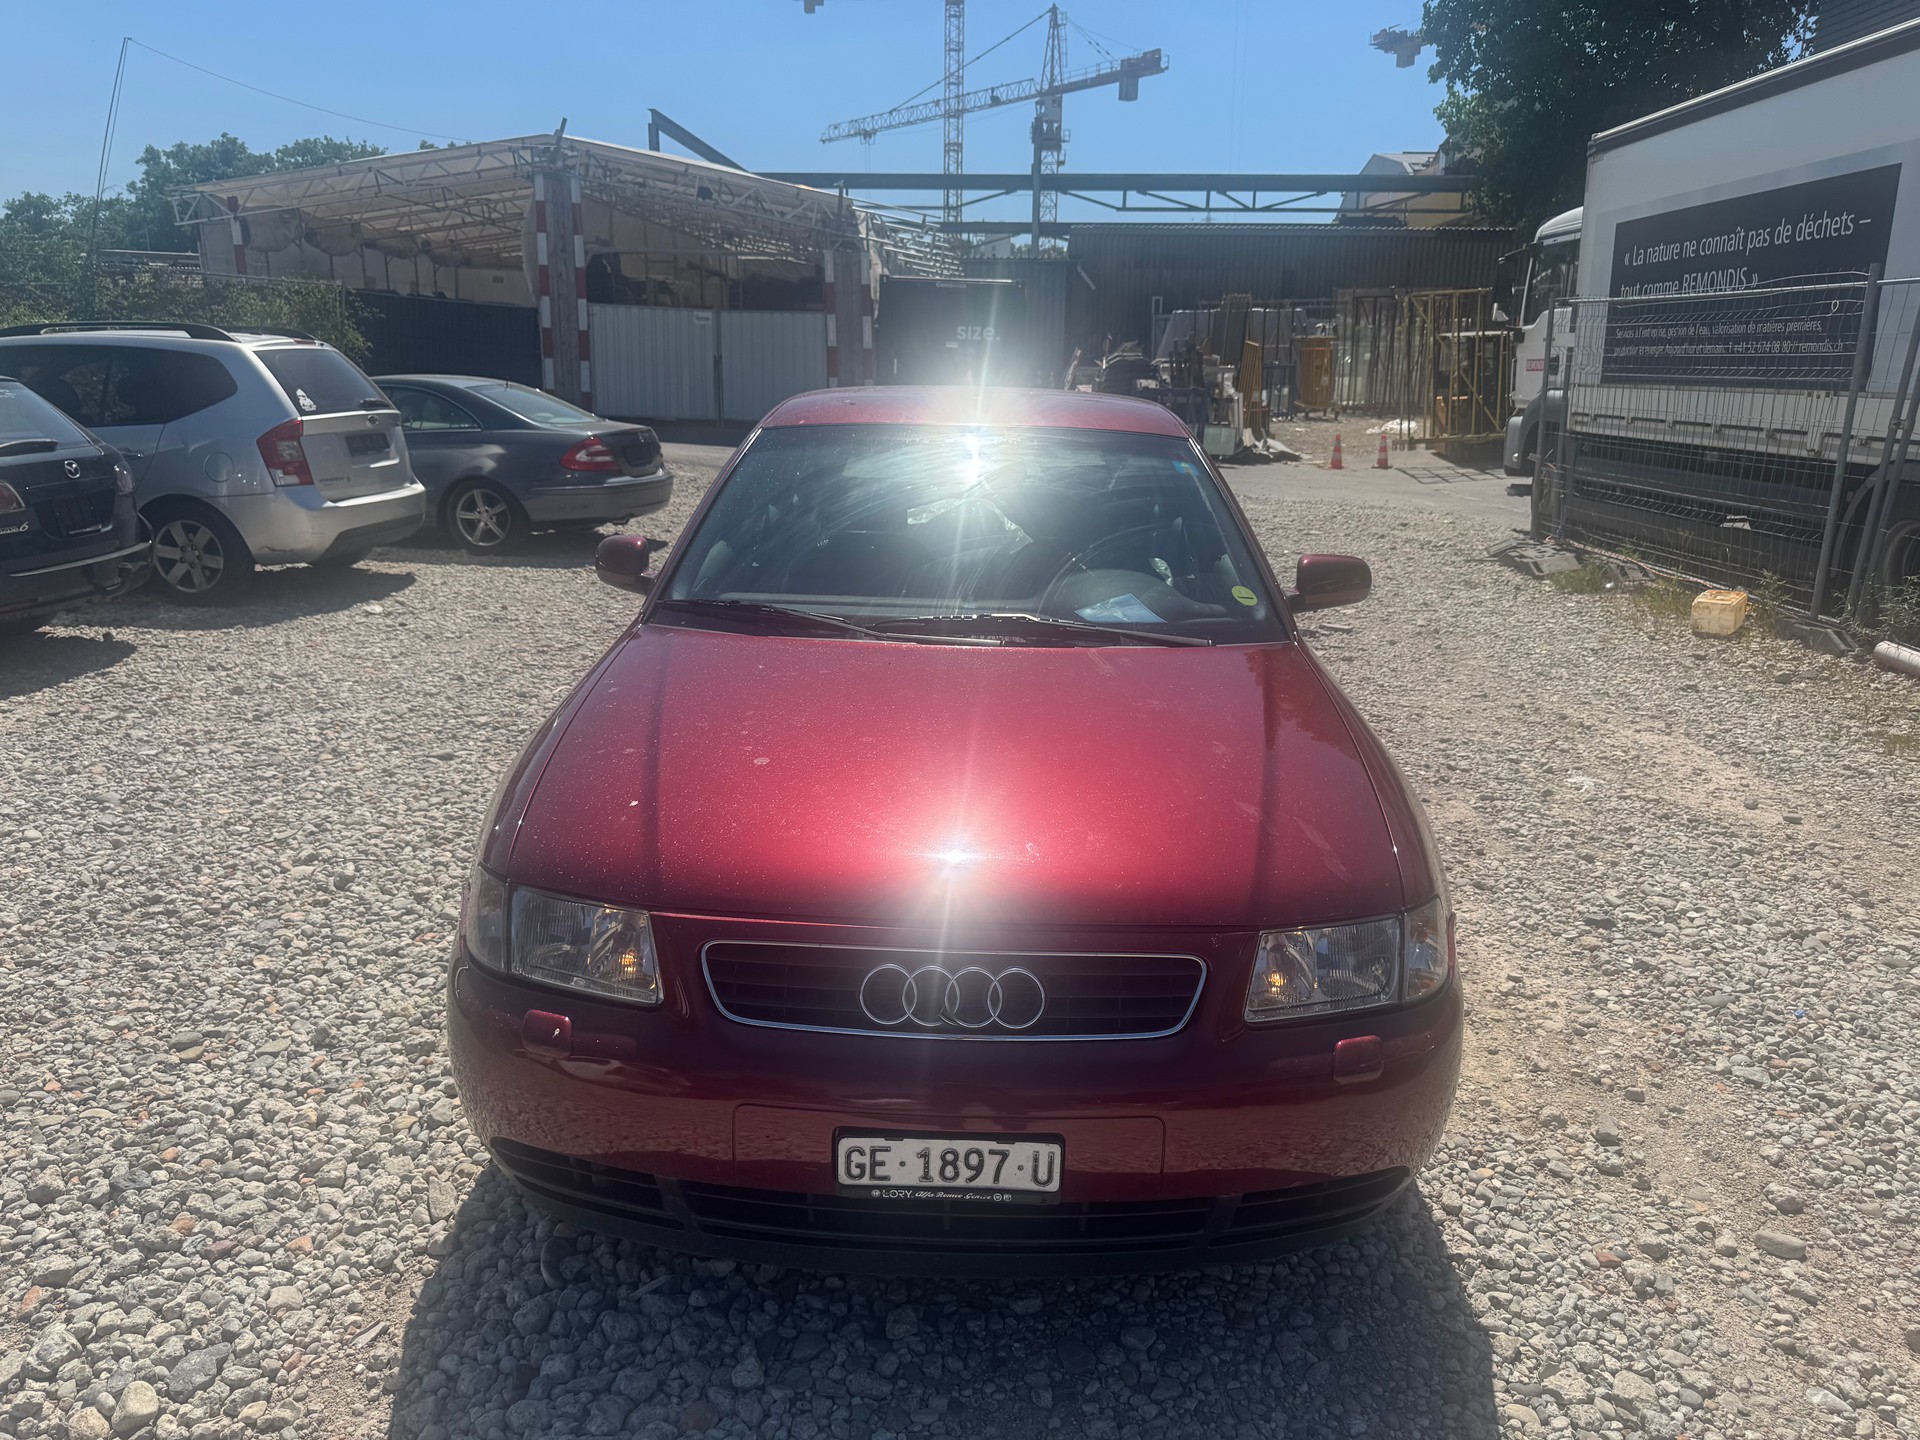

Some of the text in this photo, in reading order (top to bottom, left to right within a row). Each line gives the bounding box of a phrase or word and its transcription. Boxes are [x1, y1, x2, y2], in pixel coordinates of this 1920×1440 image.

[1632, 244, 1644, 267] La
[1646, 241, 1681, 265] nature
[1682, 240, 1697, 259] ne
[1699, 225, 1745, 254] connaît
[1746, 228, 1770, 256] pas
[1774, 217, 1792, 246] de
[1795, 210, 1855, 241] déchets
[1620, 282, 1641, 299] tout
[1641, 280, 1680, 298] comme
[1681, 266, 1748, 296] REMONDIS
[844, 1145, 1056, 1187] GE 1897 U
